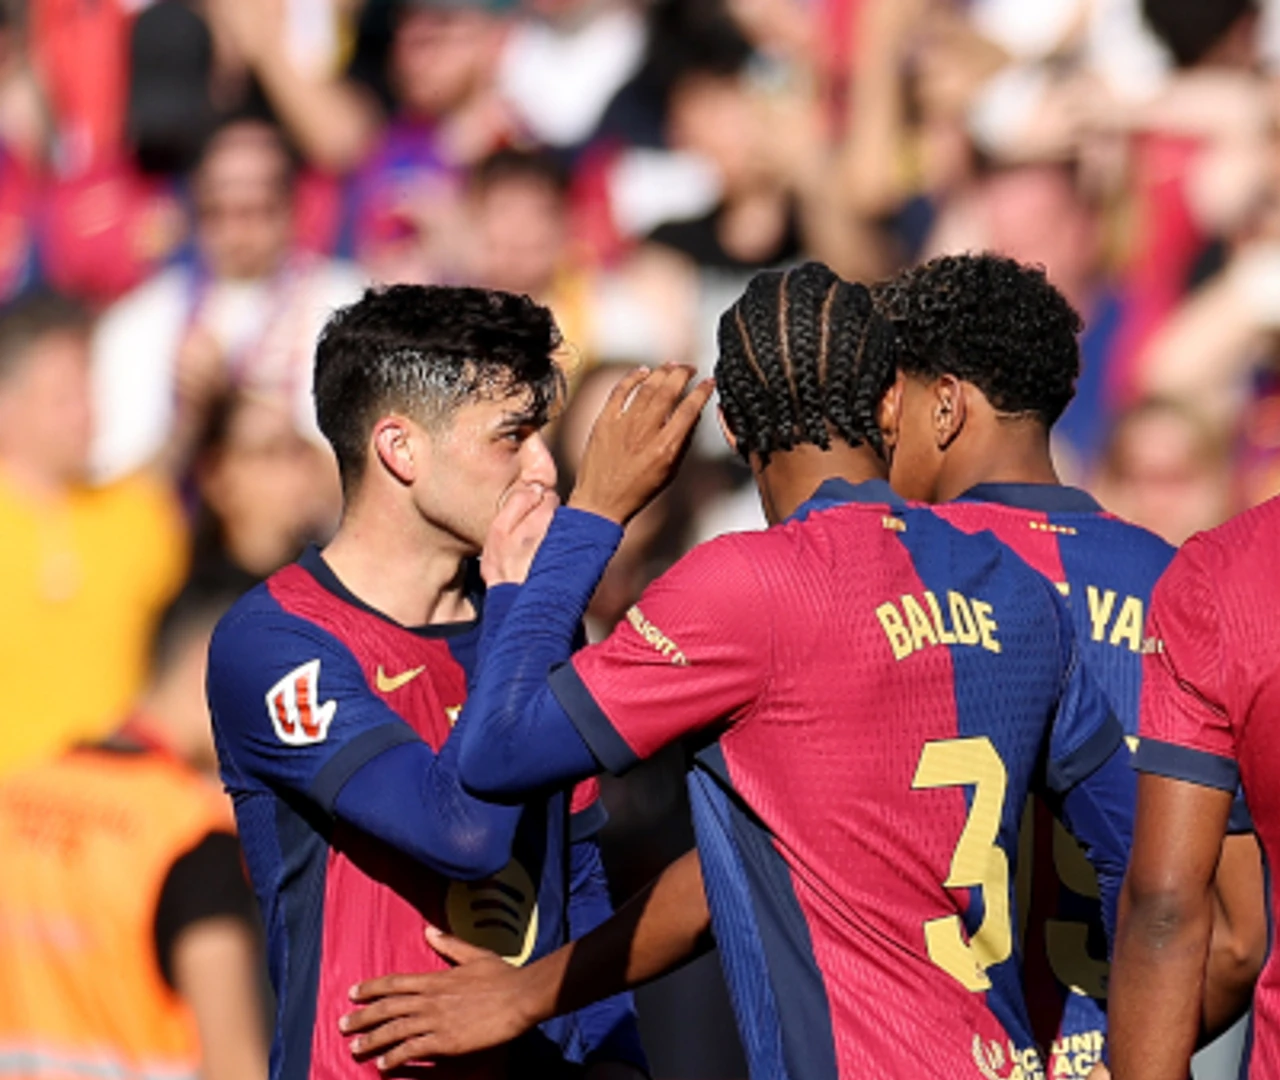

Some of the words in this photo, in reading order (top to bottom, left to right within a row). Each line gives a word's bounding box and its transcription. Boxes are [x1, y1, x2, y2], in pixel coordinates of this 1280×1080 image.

[875, 591, 1002, 661] BALDE
[1086, 585, 1143, 652] YA
[911, 736, 1012, 992] 3
